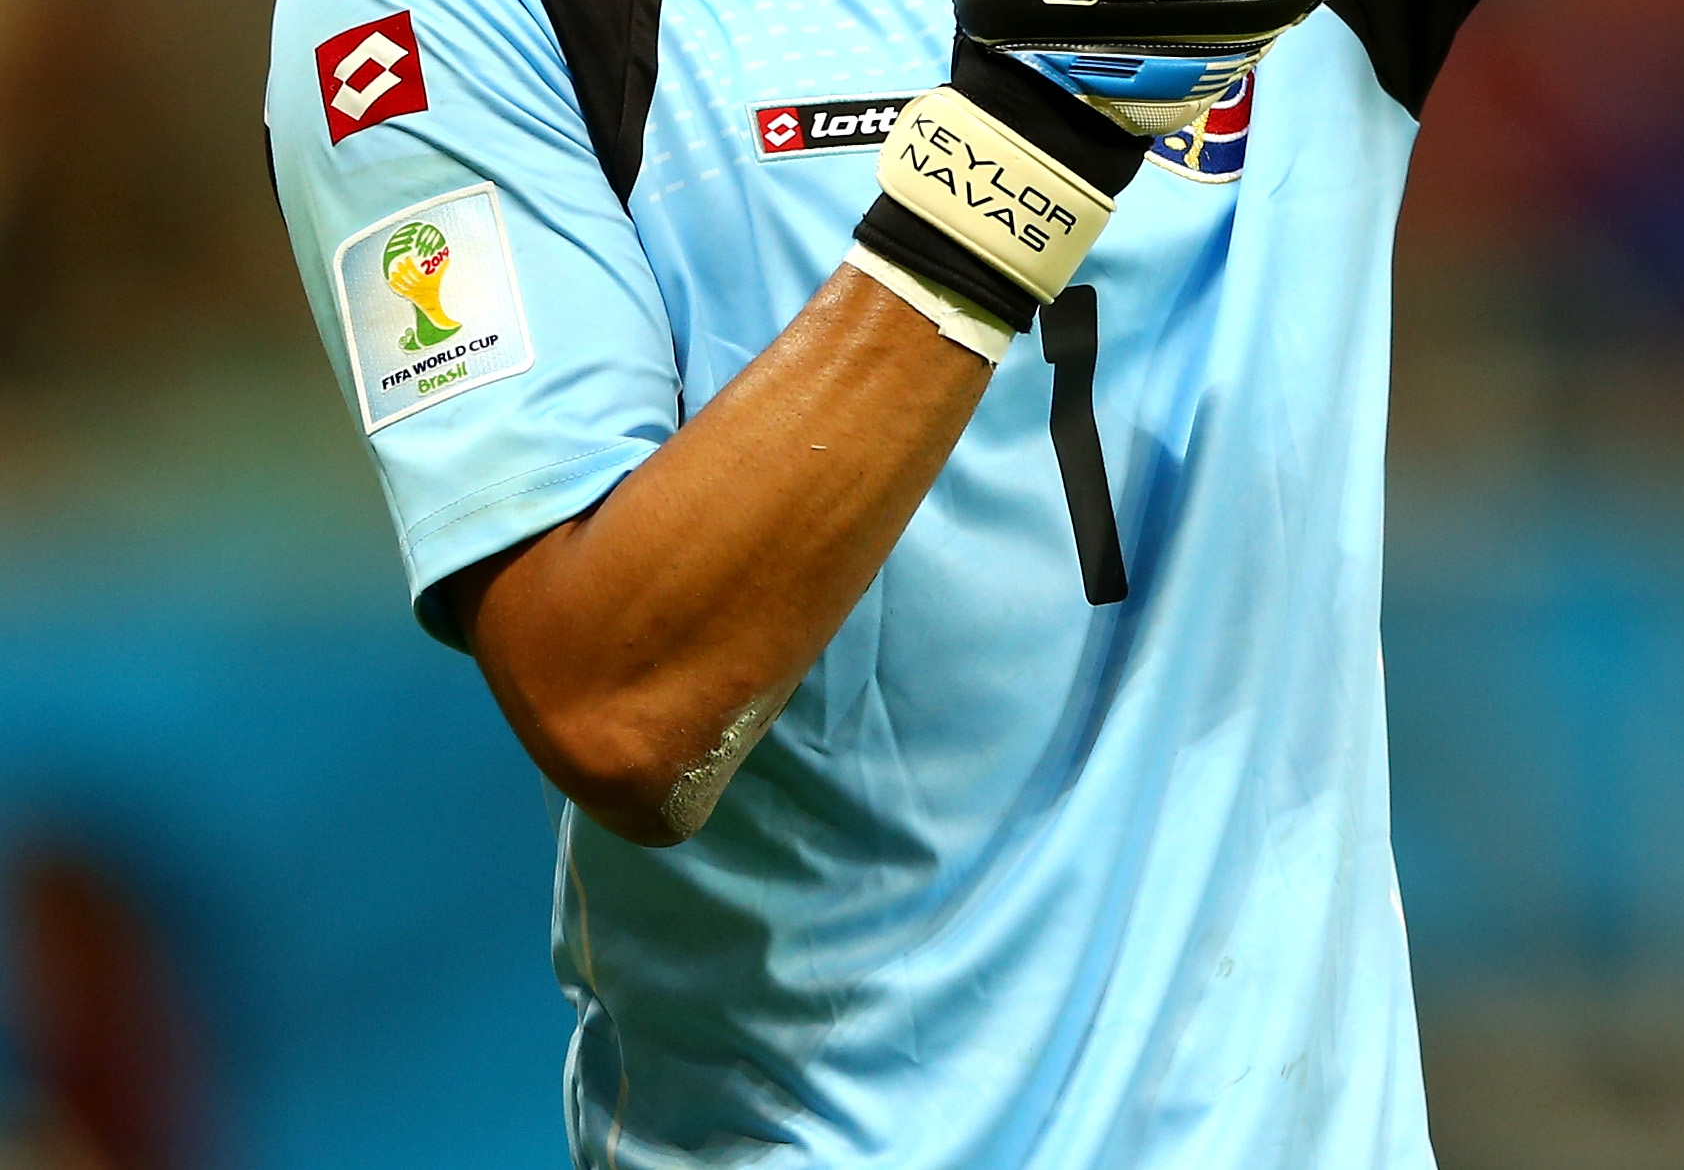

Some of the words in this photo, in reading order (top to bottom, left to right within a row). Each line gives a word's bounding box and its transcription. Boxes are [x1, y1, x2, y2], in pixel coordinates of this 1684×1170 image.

[811, 106, 898, 139] lott
[900, 144, 1051, 253] NAVAS
[911, 113, 1078, 235] KEYLOR
[420, 246, 449, 275] 2014
[382, 369, 412, 390] FIFA
[412, 345, 466, 374] WORLD
[469, 334, 498, 352] CUP
[1039, 284, 1129, 606] 1
